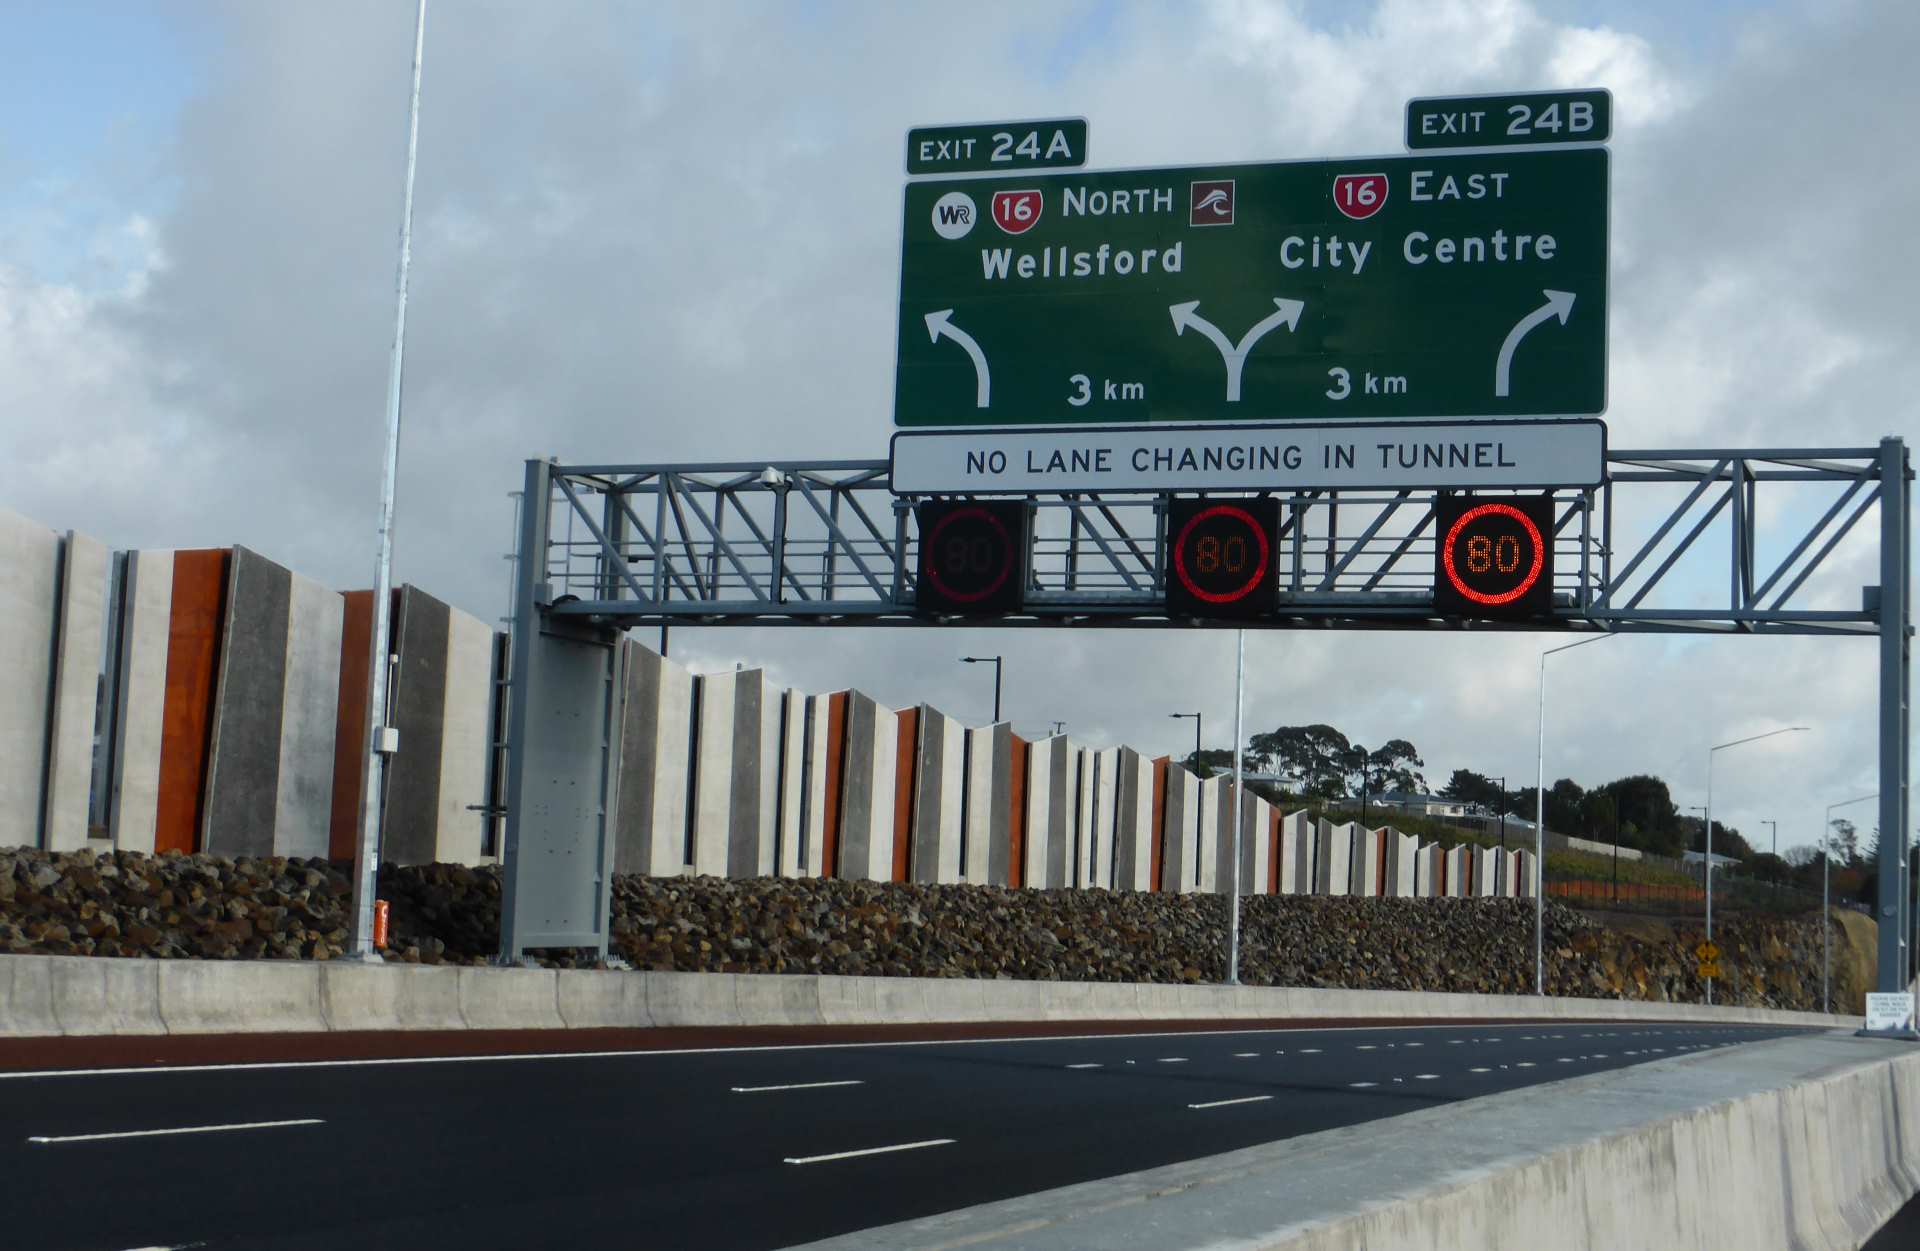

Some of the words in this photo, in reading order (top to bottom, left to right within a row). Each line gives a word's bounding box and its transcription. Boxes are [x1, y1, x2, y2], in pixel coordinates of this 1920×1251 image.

[1422, 111, 1486, 136] EXIT
[1506, 101, 1594, 136] 24B
[920, 138, 977, 162] EXIT
[990, 129, 1072, 162] 24A
[1002, 196, 1032, 222] 16
[1062, 187, 1174, 217] NORTH
[1344, 180, 1377, 206] 16
[1410, 170, 1509, 201] EAST
[981, 241, 1183, 280] Wellsford
[1279, 235, 1373, 275] City
[1402, 229, 1558, 265] Centre
[1067, 374, 1092, 407] 3
[1103, 378, 1145, 400] km
[1325, 366, 1351, 400] 3
[1364, 372, 1408, 394] km
[966, 450, 1007, 475] NO
[1026, 448, 1113, 473] LANE
[1131, 444, 1303, 472] CHANGING
[1323, 444, 1354, 470] IN
[1377, 441, 1517, 469] TUNNEL
[1194, 535, 1246, 574] 80
[1465, 534, 1520, 574] 80
